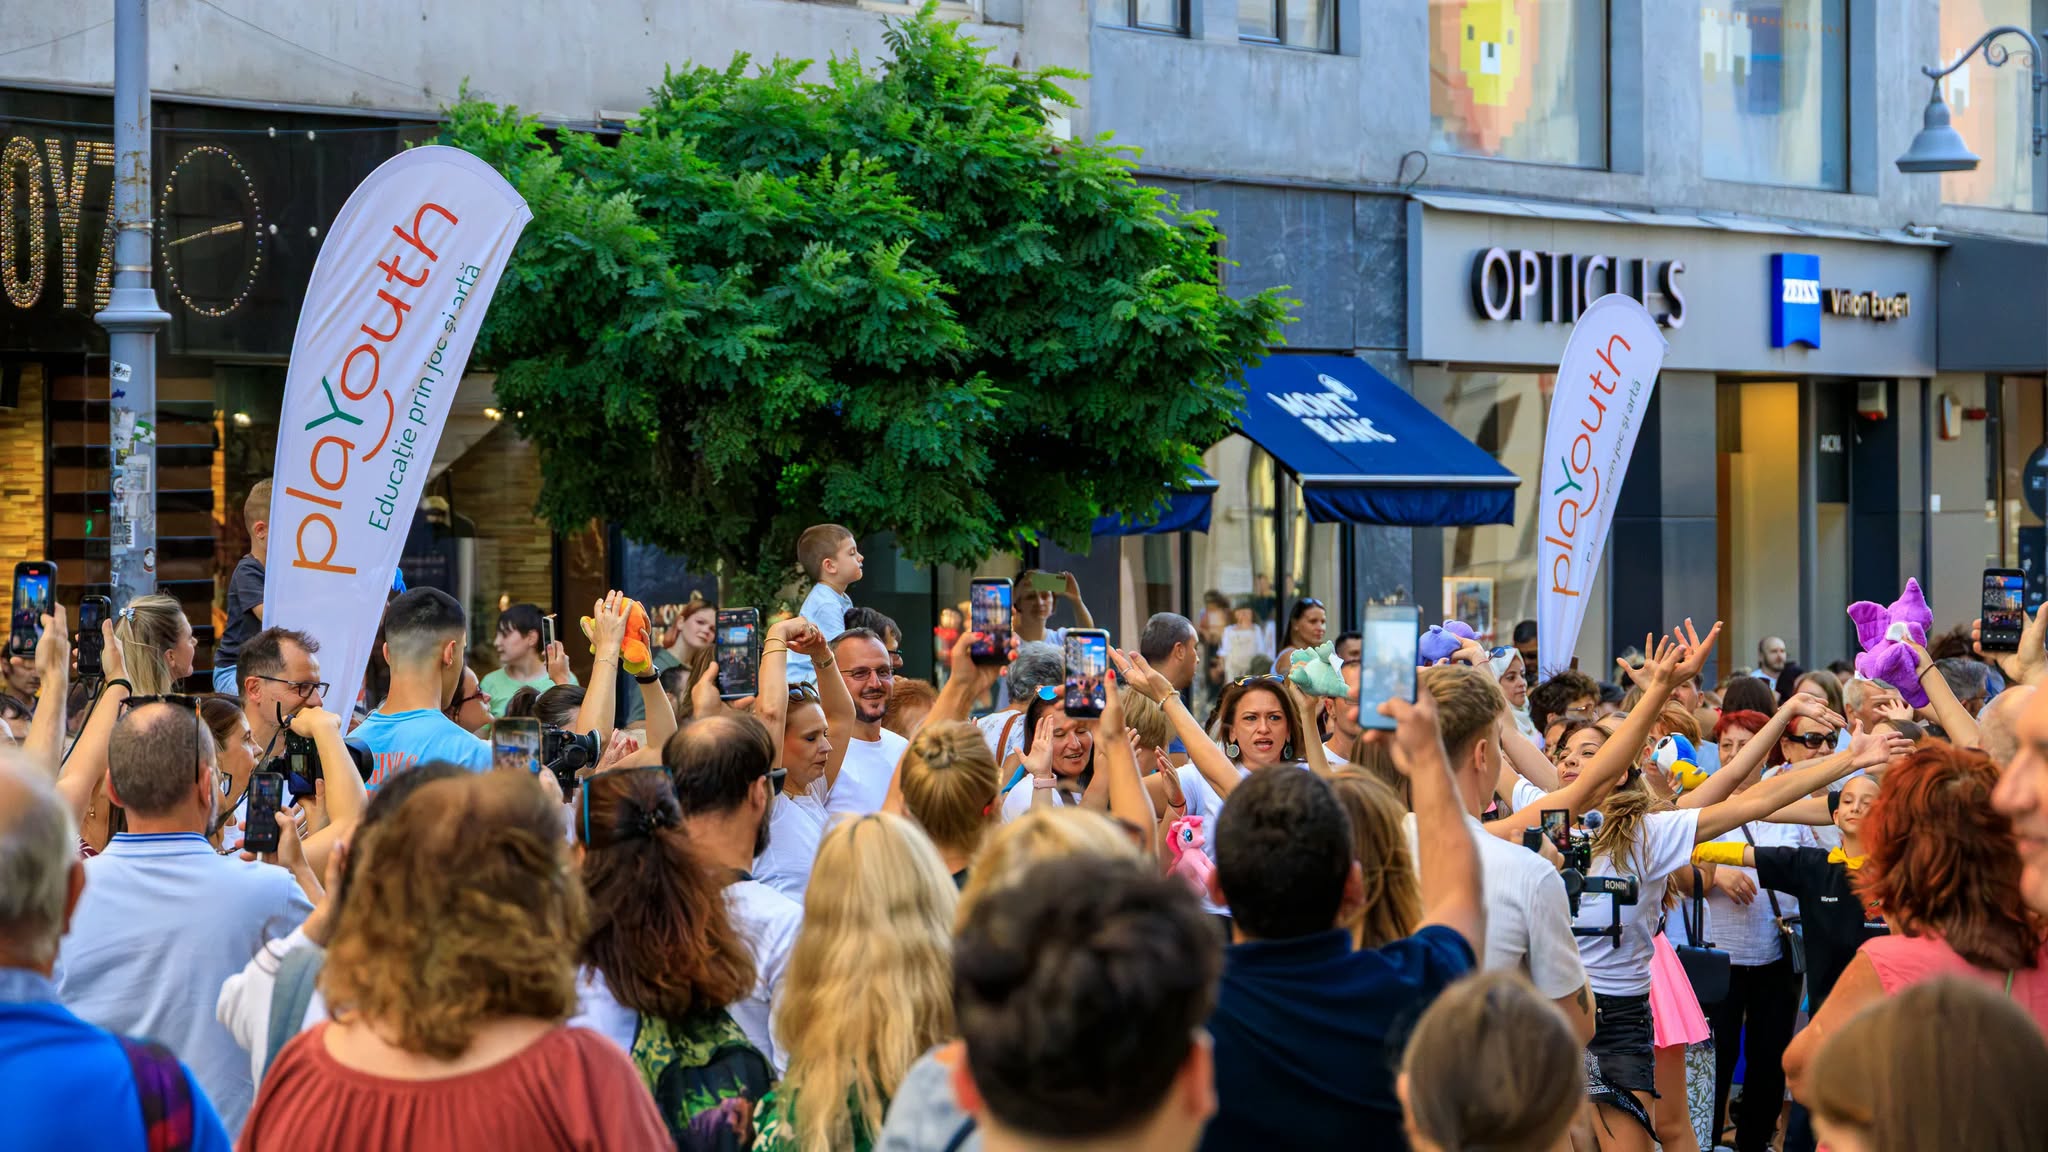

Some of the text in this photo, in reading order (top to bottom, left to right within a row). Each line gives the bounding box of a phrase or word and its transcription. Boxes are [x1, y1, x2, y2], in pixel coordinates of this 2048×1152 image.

[408, 376, 435, 426] prin
[424, 336, 448, 377] joc
[453, 261, 481, 310] artă
[1829, 288, 1869, 316] Vision
[286, 203, 459, 575] plaYouth
[1301, 417, 1397, 443] BLANC
[1545, 334, 1631, 597] plaYouth
[1604, 879, 1628, 890] RONIN
